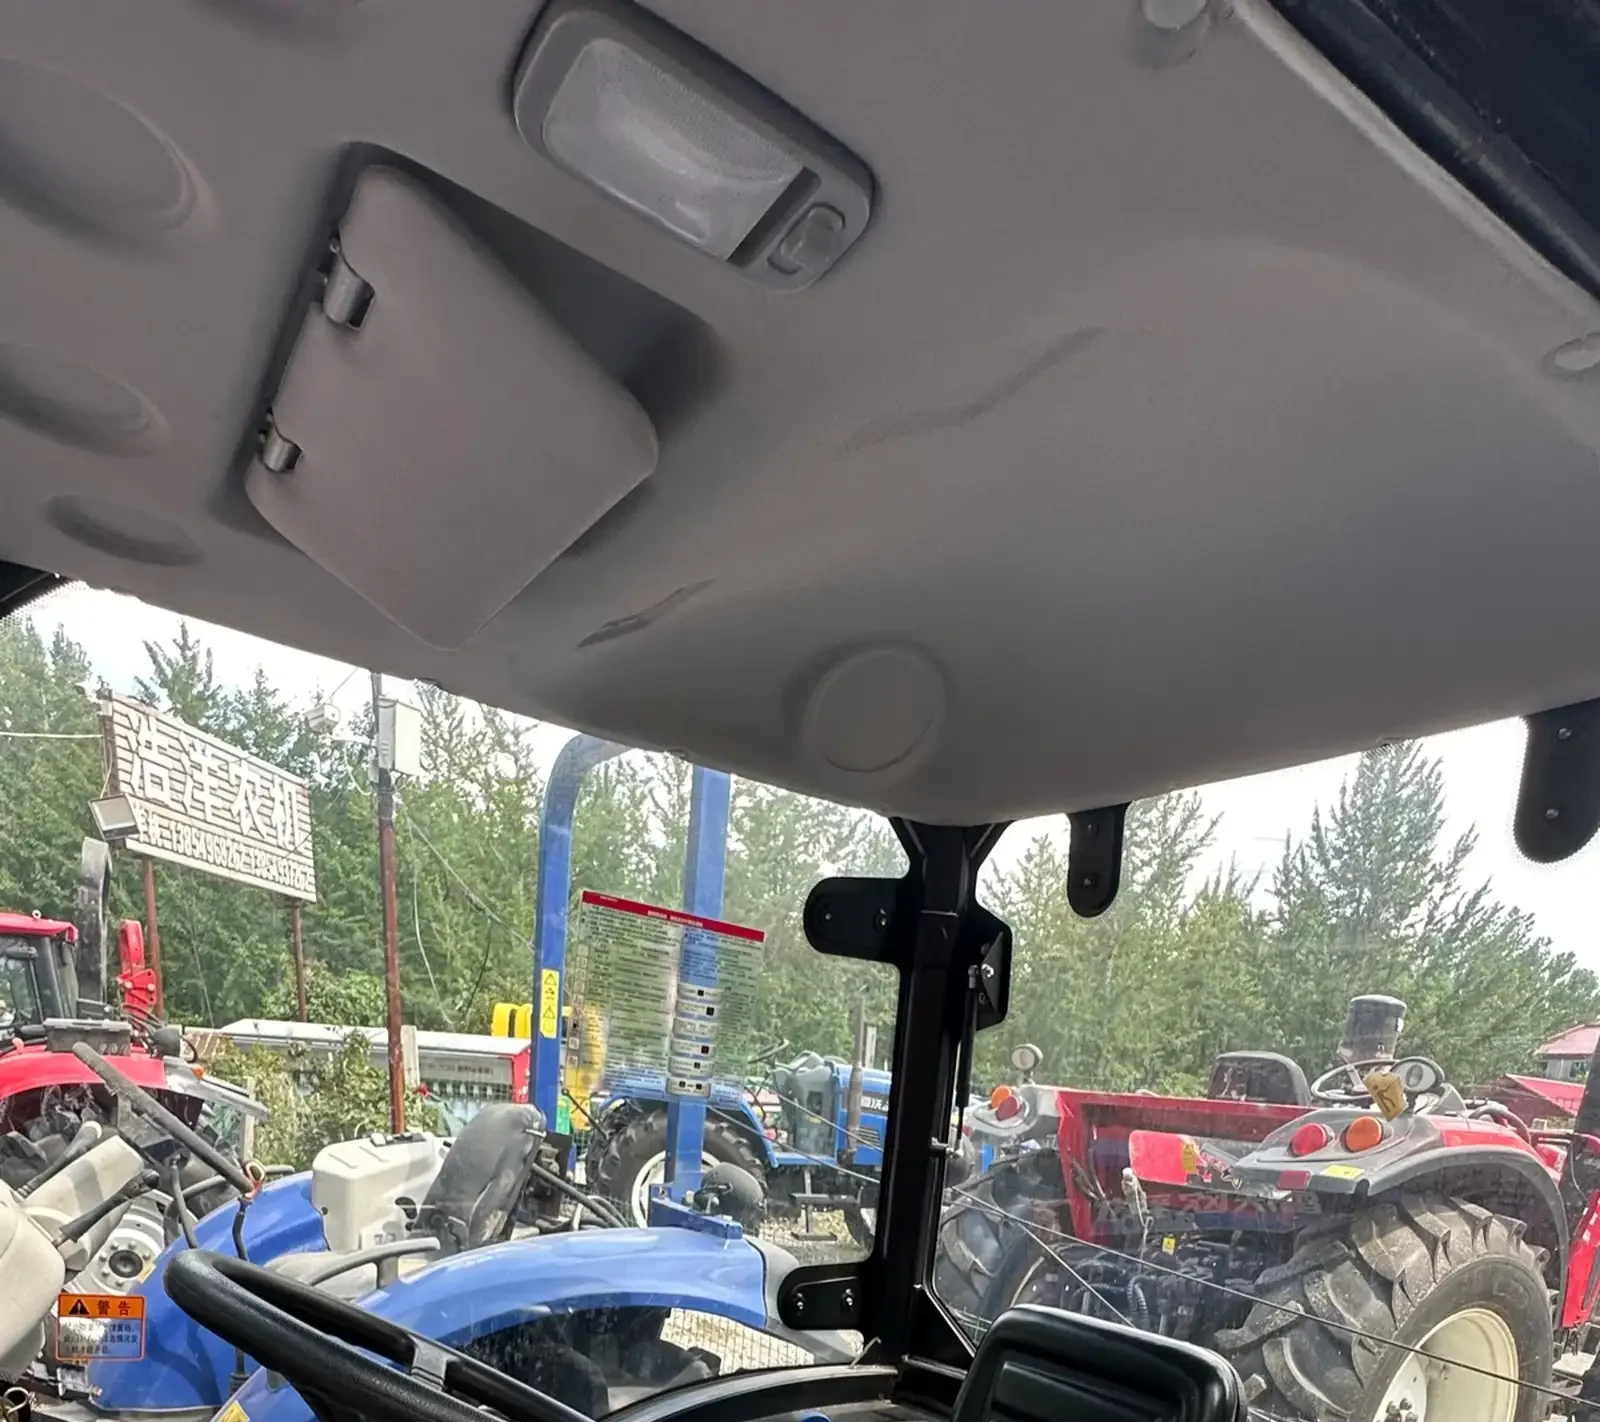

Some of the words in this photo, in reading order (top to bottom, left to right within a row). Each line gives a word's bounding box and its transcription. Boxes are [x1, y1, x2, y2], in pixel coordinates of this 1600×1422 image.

[127, 711, 300, 851] 浩洋农机
[97, 1300, 130, 1316] 警告
